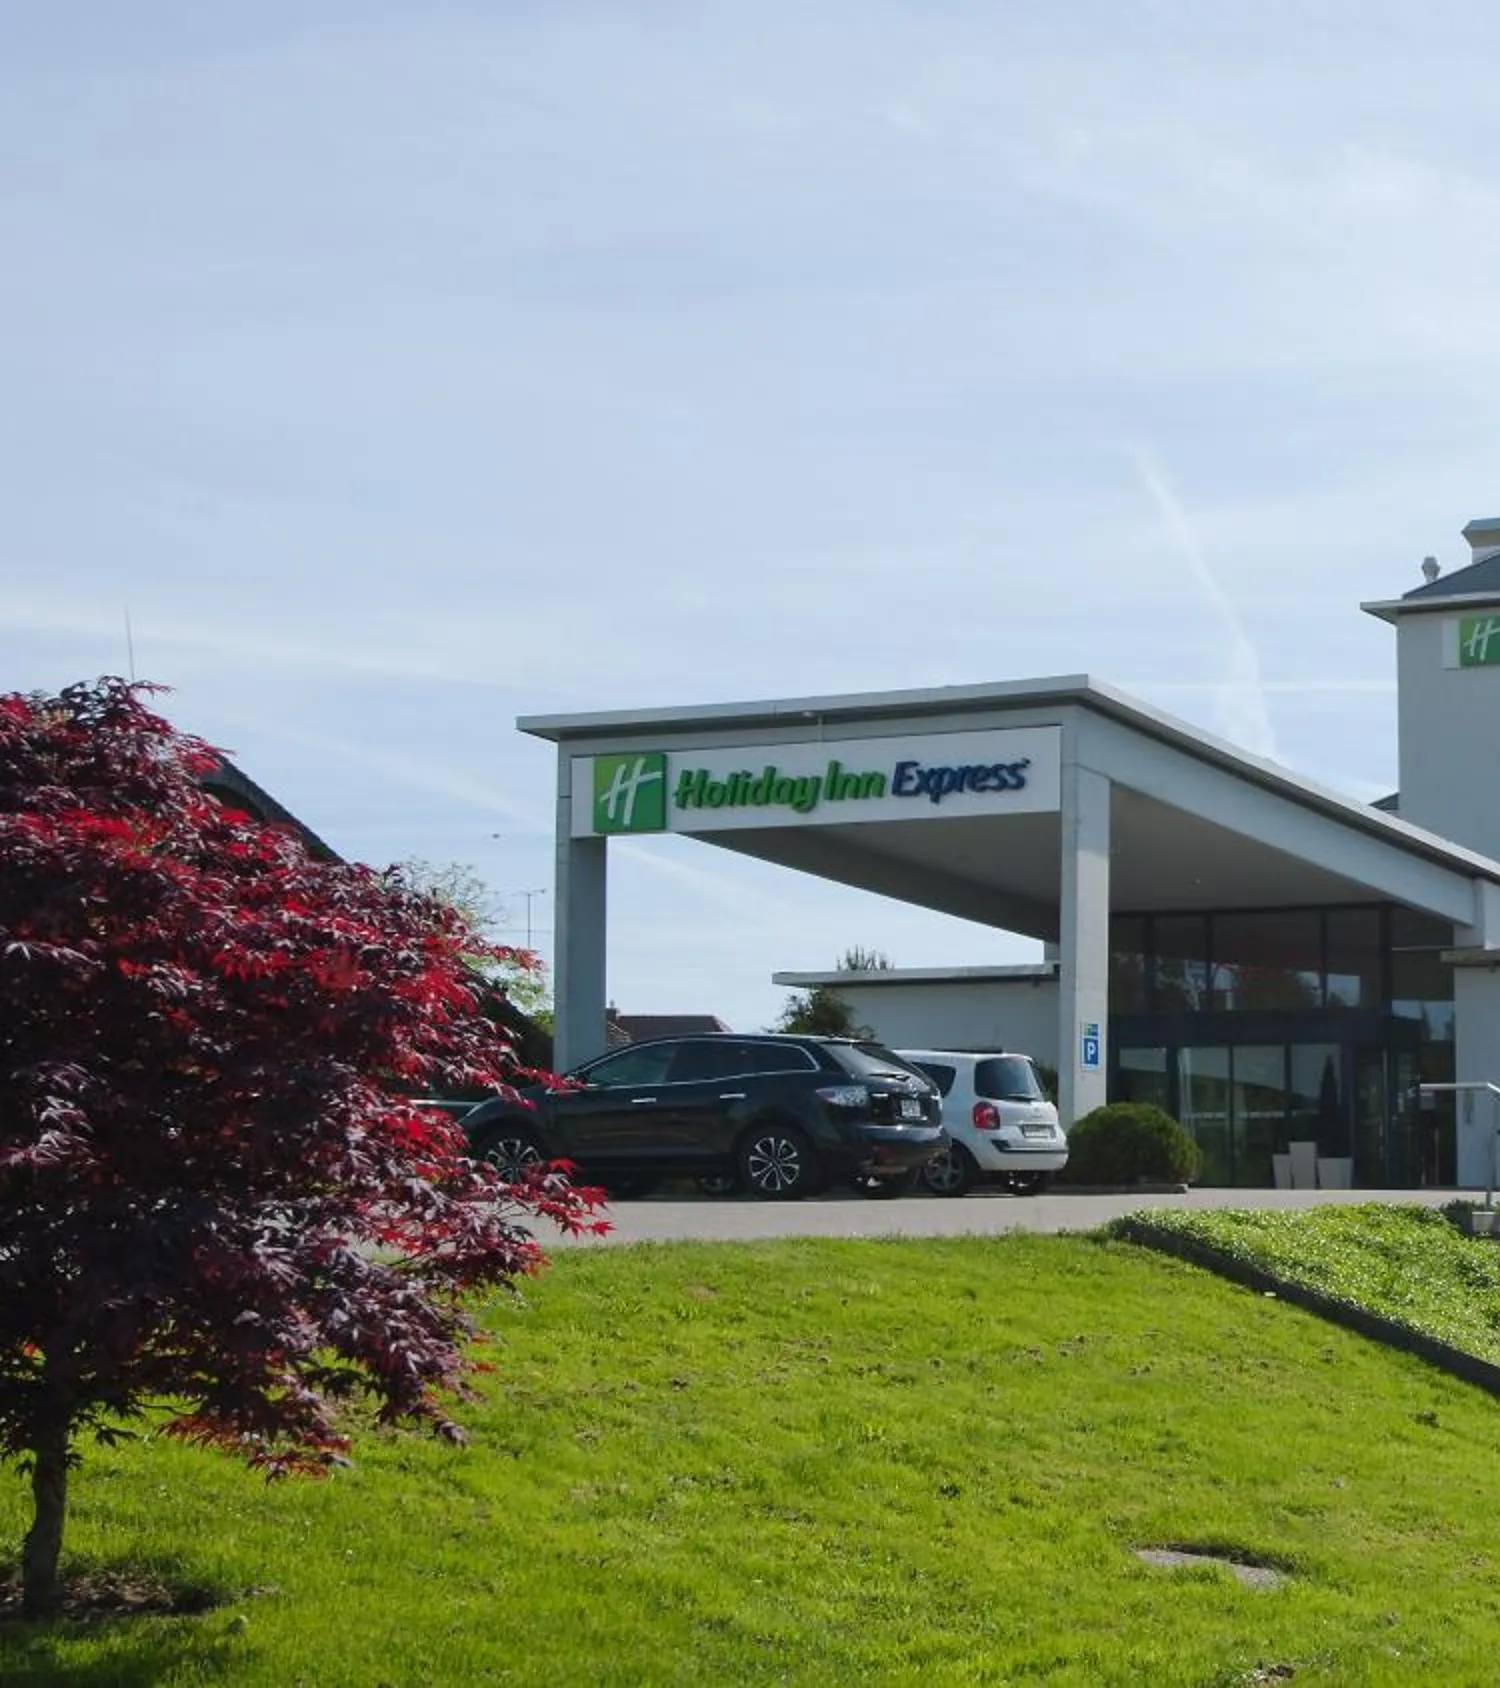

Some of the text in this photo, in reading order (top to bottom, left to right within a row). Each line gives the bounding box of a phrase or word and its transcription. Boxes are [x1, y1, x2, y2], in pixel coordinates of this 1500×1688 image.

[673, 759, 1029, 814] Holiday Inn Express
[1087, 1041, 1097, 1061] P
